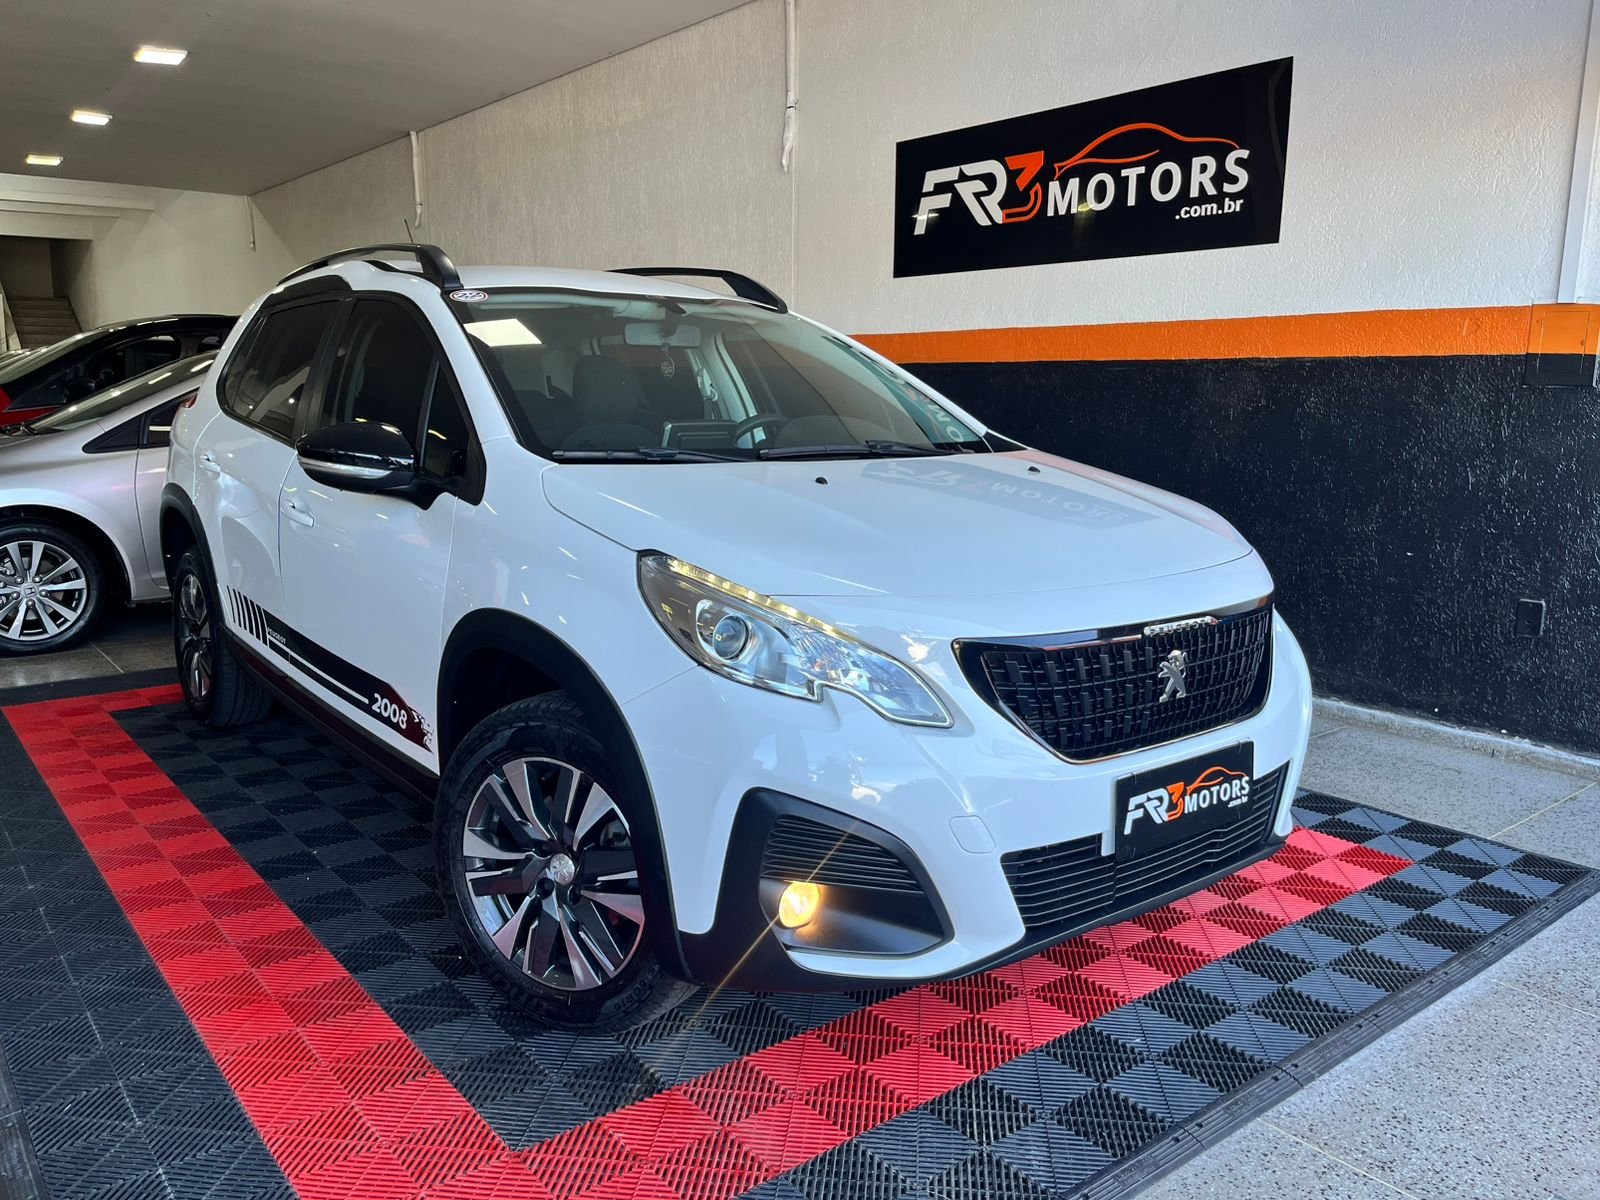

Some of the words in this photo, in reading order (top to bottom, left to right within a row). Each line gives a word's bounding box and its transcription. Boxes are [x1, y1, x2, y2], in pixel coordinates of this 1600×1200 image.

[913, 150, 1044, 236] FR3
[1046, 148, 1250, 217] MOTORS
[1174, 197, 1245, 220] .com.br
[371, 692, 408, 730] 2008
[1123, 781, 1184, 835] FR3
[1184, 776, 1250, 814] MOTORS
